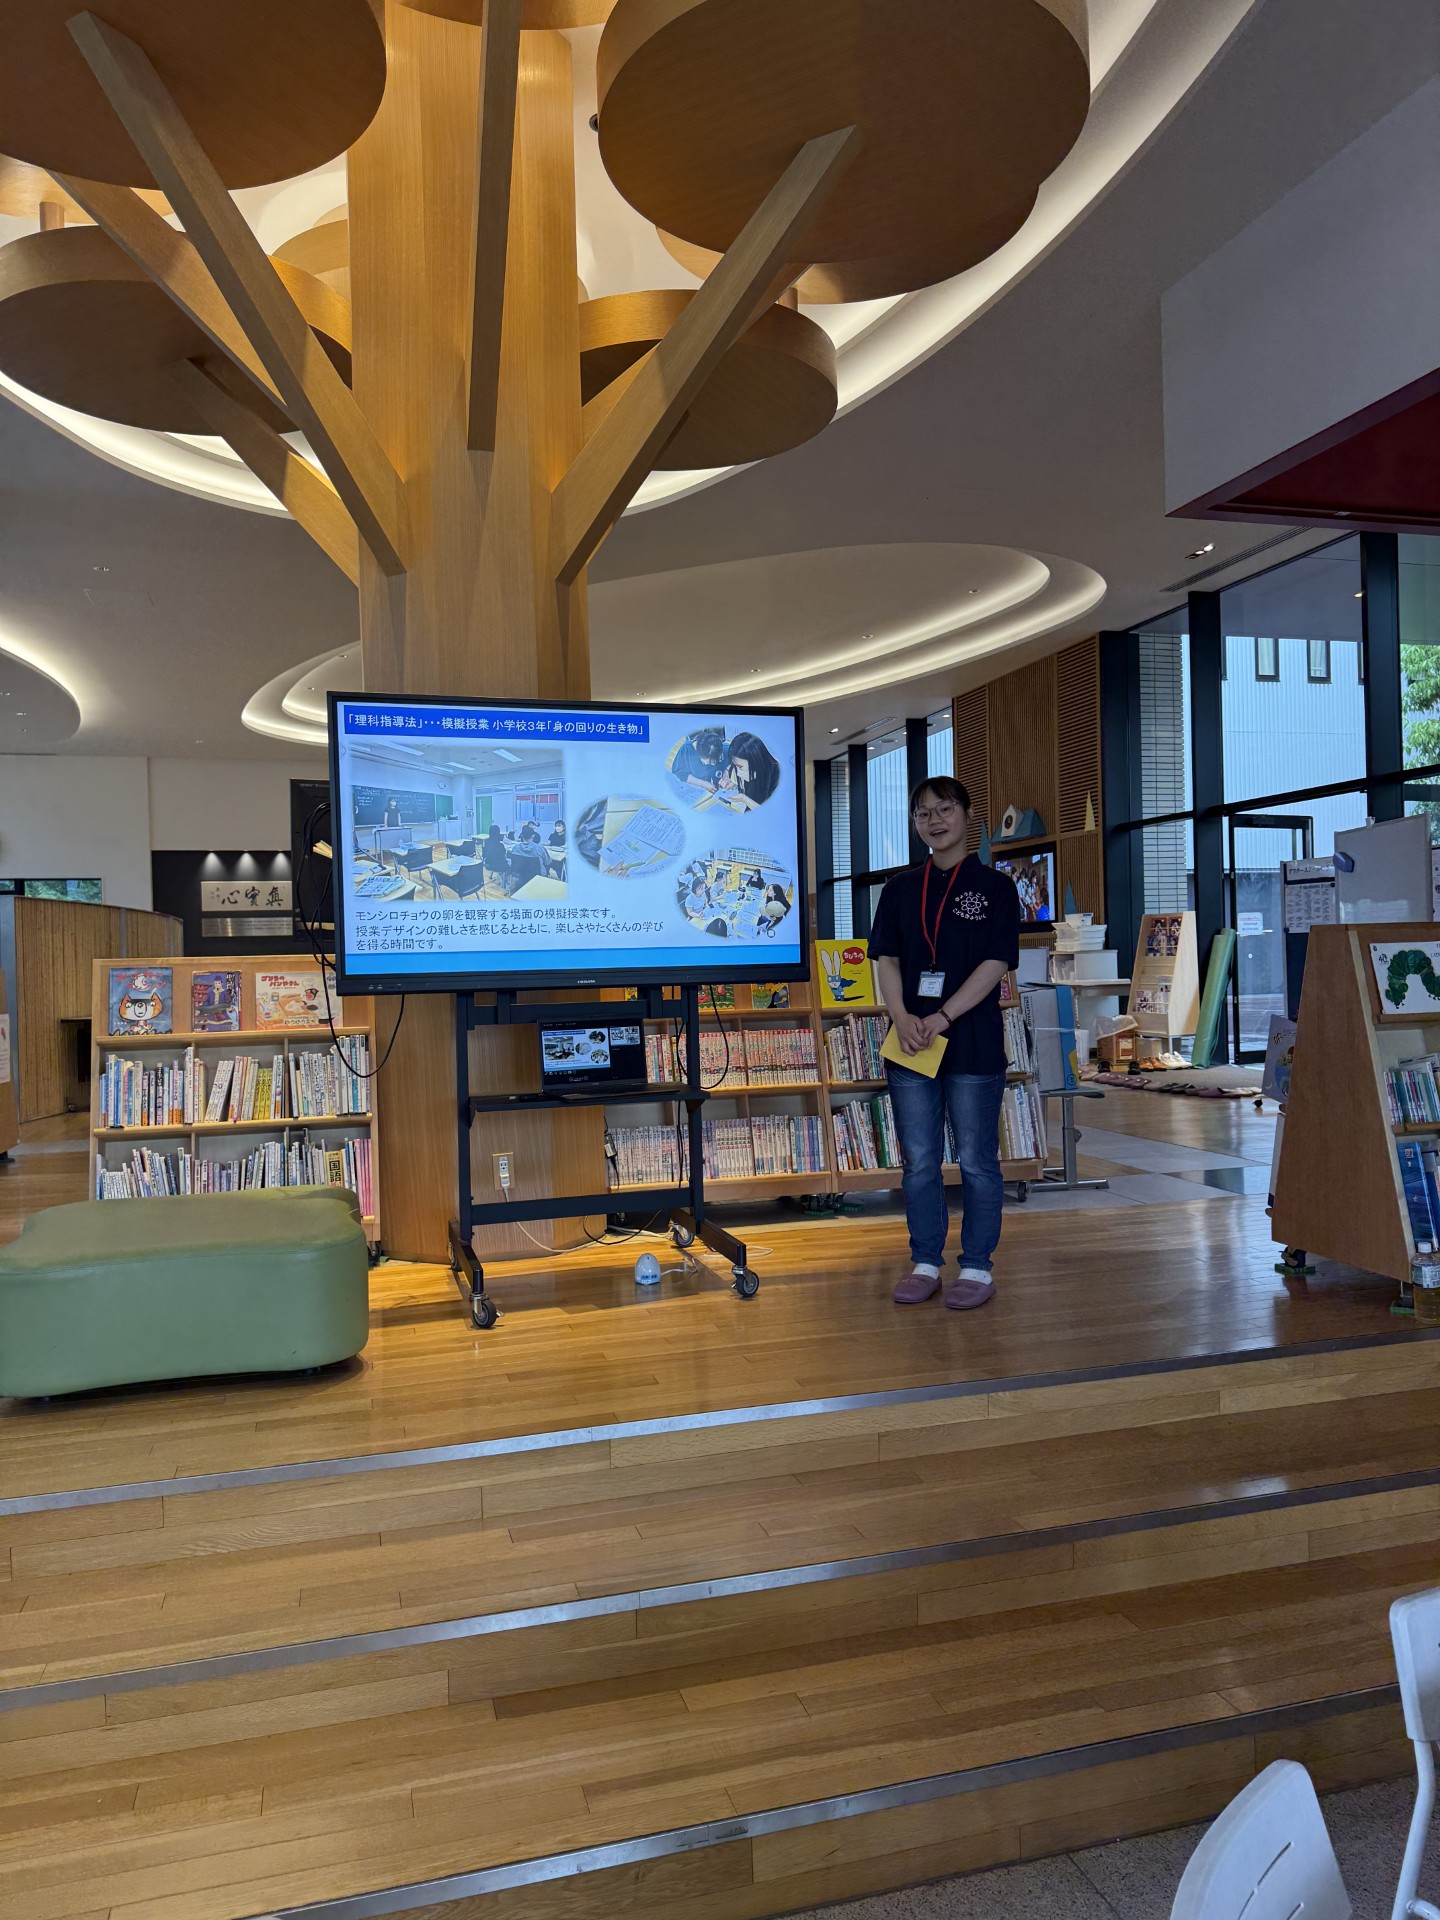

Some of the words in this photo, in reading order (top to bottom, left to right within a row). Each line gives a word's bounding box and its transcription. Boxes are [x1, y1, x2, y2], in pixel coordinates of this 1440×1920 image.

[492, 719, 643, 735] 小学校3年「身の回りの生き物」
[355, 907, 616, 921] モンシロチョウの卵を観察する場面の模擬授業です。
[356, 938, 443, 950] を得る時間です。
